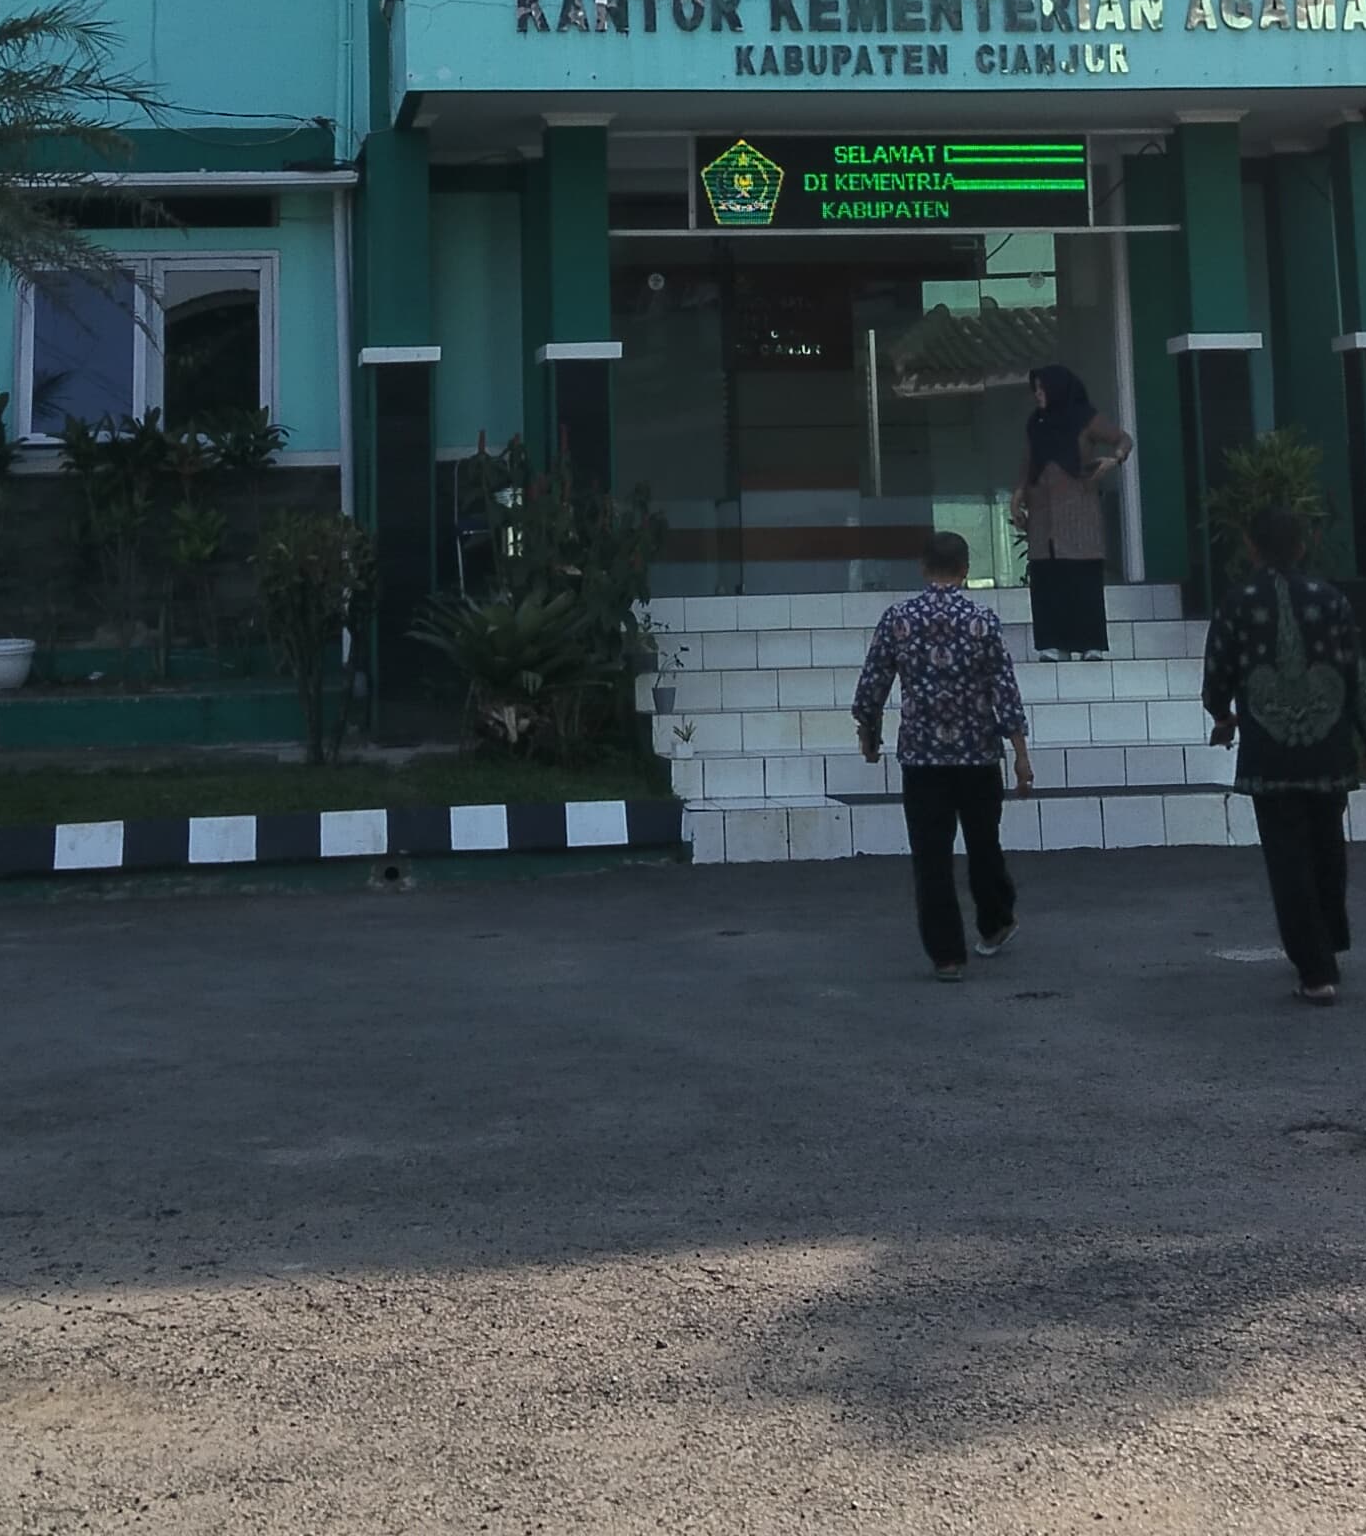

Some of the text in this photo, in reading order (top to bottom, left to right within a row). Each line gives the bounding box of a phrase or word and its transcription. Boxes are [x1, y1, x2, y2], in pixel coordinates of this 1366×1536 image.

[735, 43, 1130, 76] KABUPATEN CIANJUR
[834, 144, 937, 164] SELAMAT
[803, 172, 828, 192] DI
[821, 200, 950, 219] KABUPATEN
